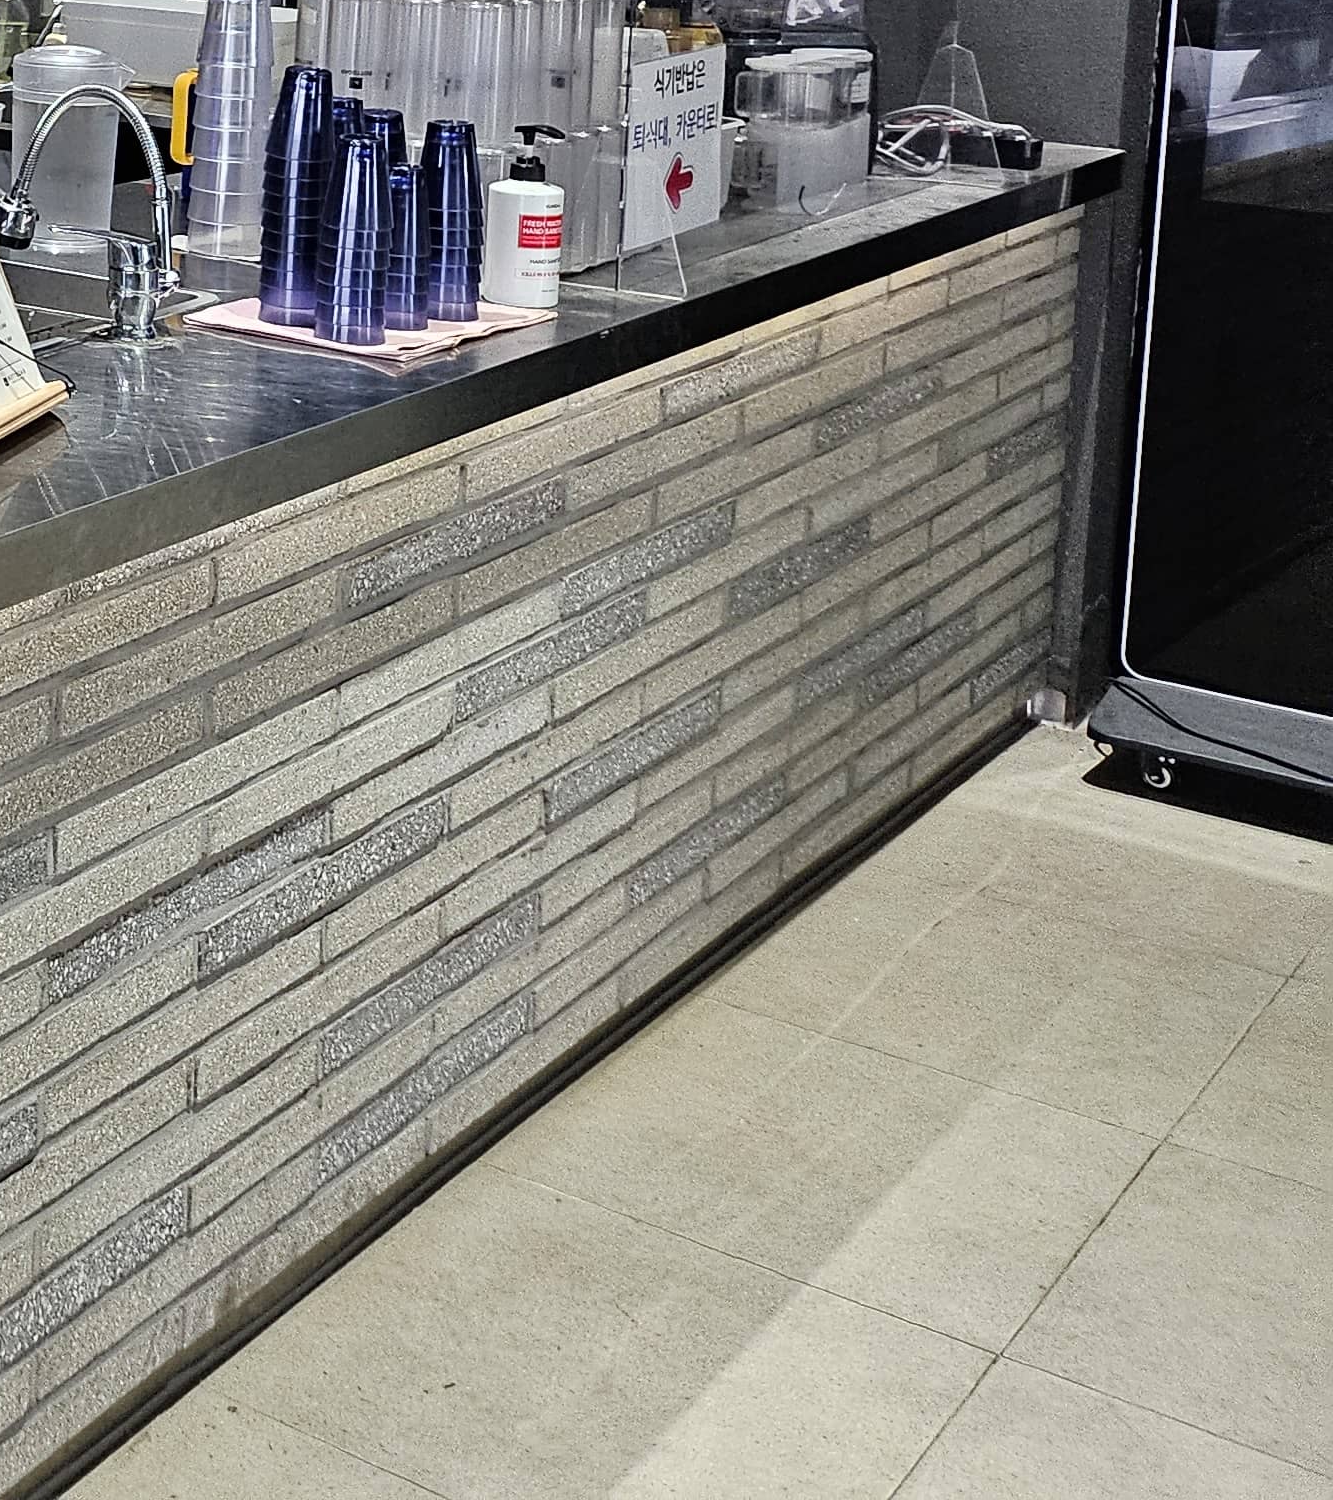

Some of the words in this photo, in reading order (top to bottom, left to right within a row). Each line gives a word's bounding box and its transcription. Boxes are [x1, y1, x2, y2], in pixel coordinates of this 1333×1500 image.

[653, 58, 707, 98] 식기반납은
[632, 121, 672, 153] 퇴식대,
[675, 102, 719, 142] 카운터로
